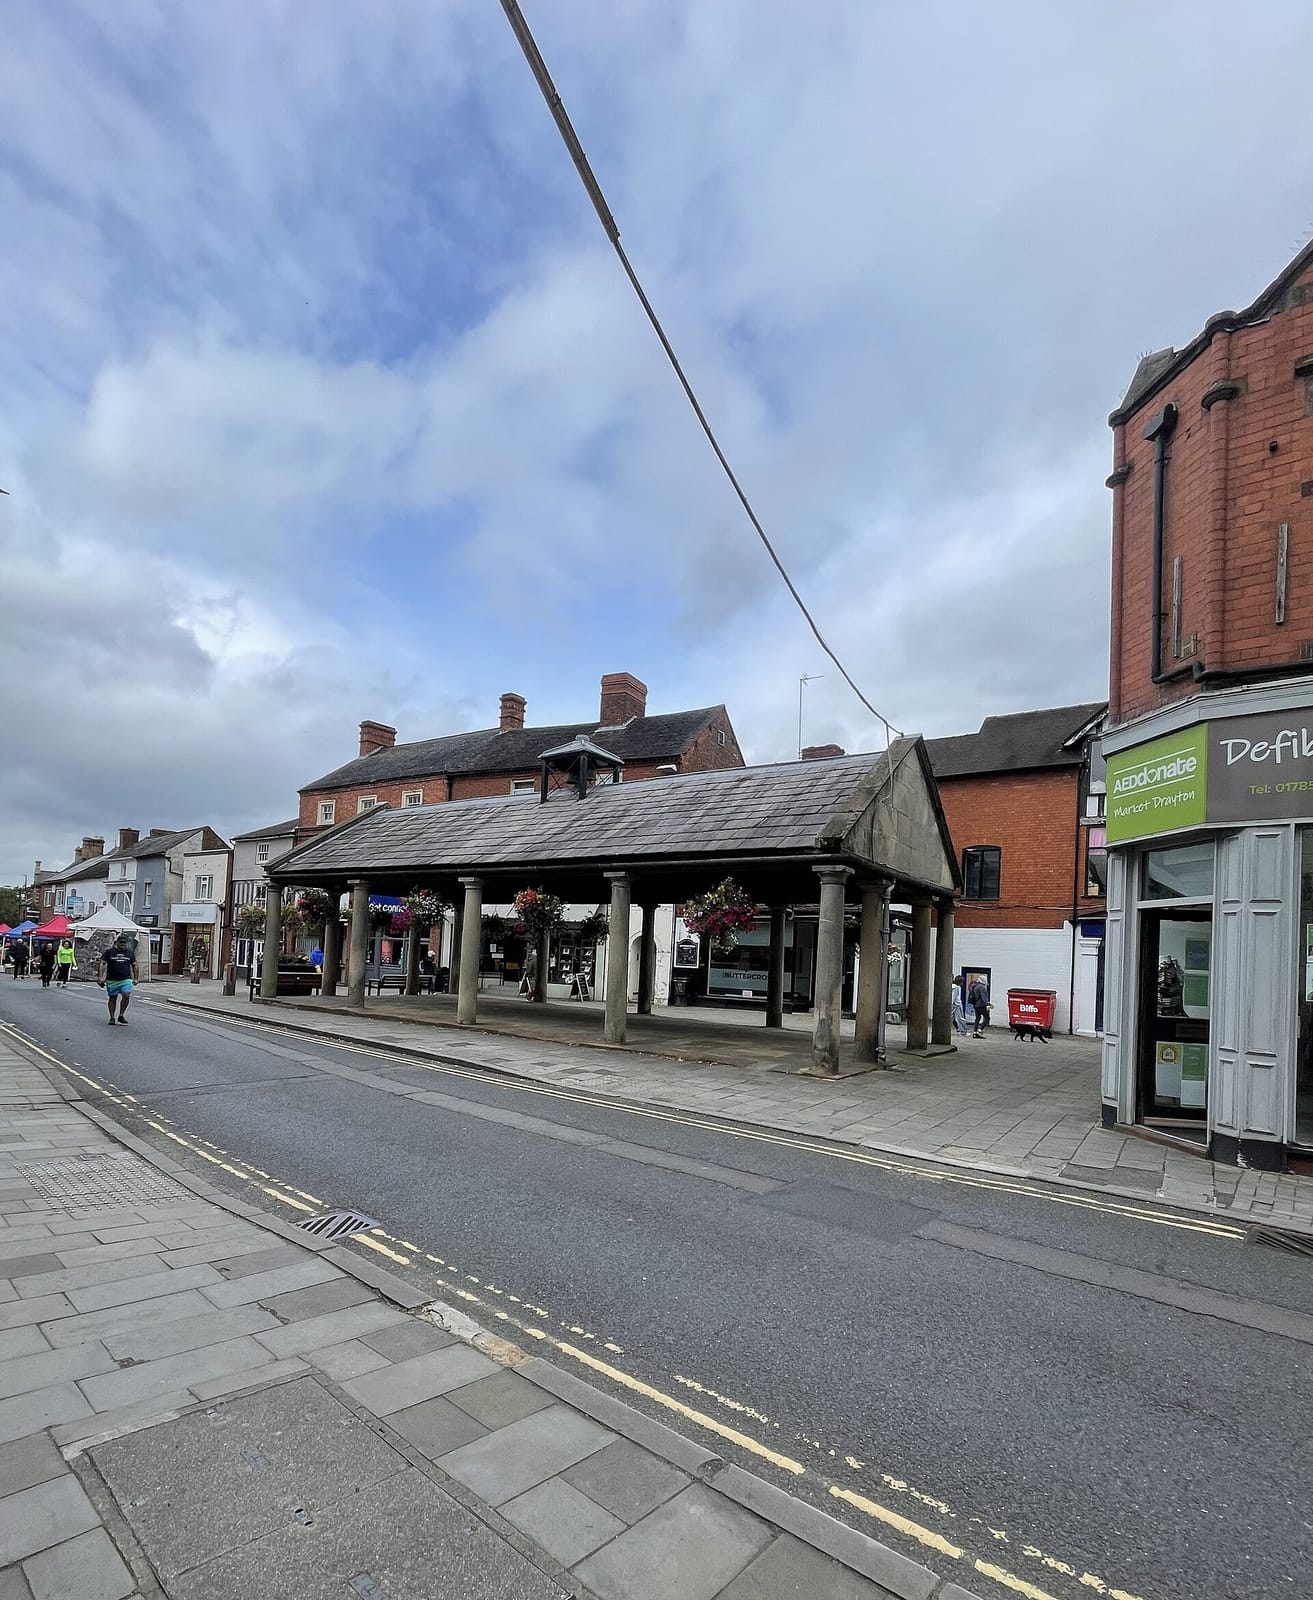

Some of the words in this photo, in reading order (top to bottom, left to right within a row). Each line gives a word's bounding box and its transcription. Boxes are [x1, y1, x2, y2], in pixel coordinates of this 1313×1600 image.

[1248, 784, 1271, 795] Tel:
[1113, 800, 1150, 818] Market
[1152, 790, 1195, 809] Drayton
[723, 972, 768, 981] BUTTERCRO
